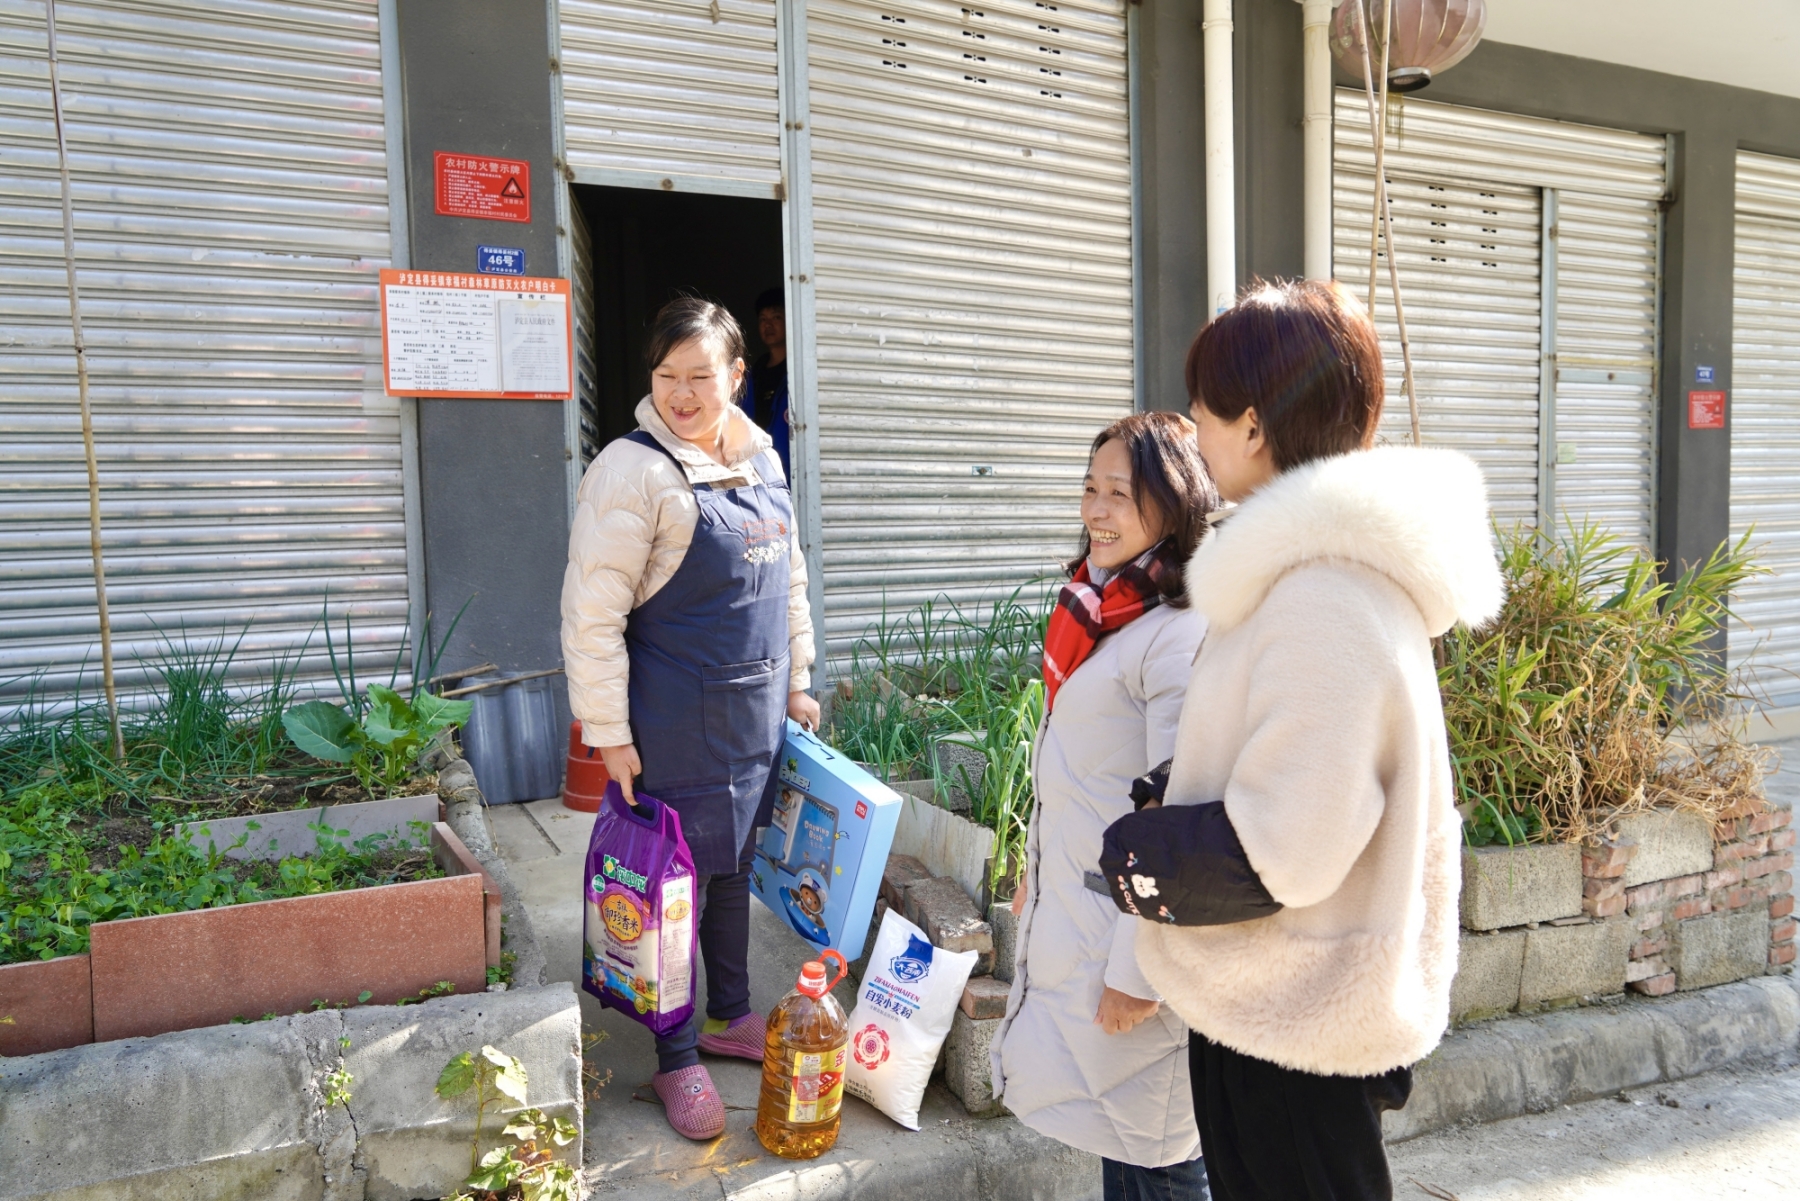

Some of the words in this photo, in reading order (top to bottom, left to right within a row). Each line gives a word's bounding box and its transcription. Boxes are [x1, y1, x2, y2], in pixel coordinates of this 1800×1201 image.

[445, 157, 520, 175] 农村防火警示牌
[488, 255, 514, 267] 46号
[865, 989, 913, 1019] 自发小麦粉
